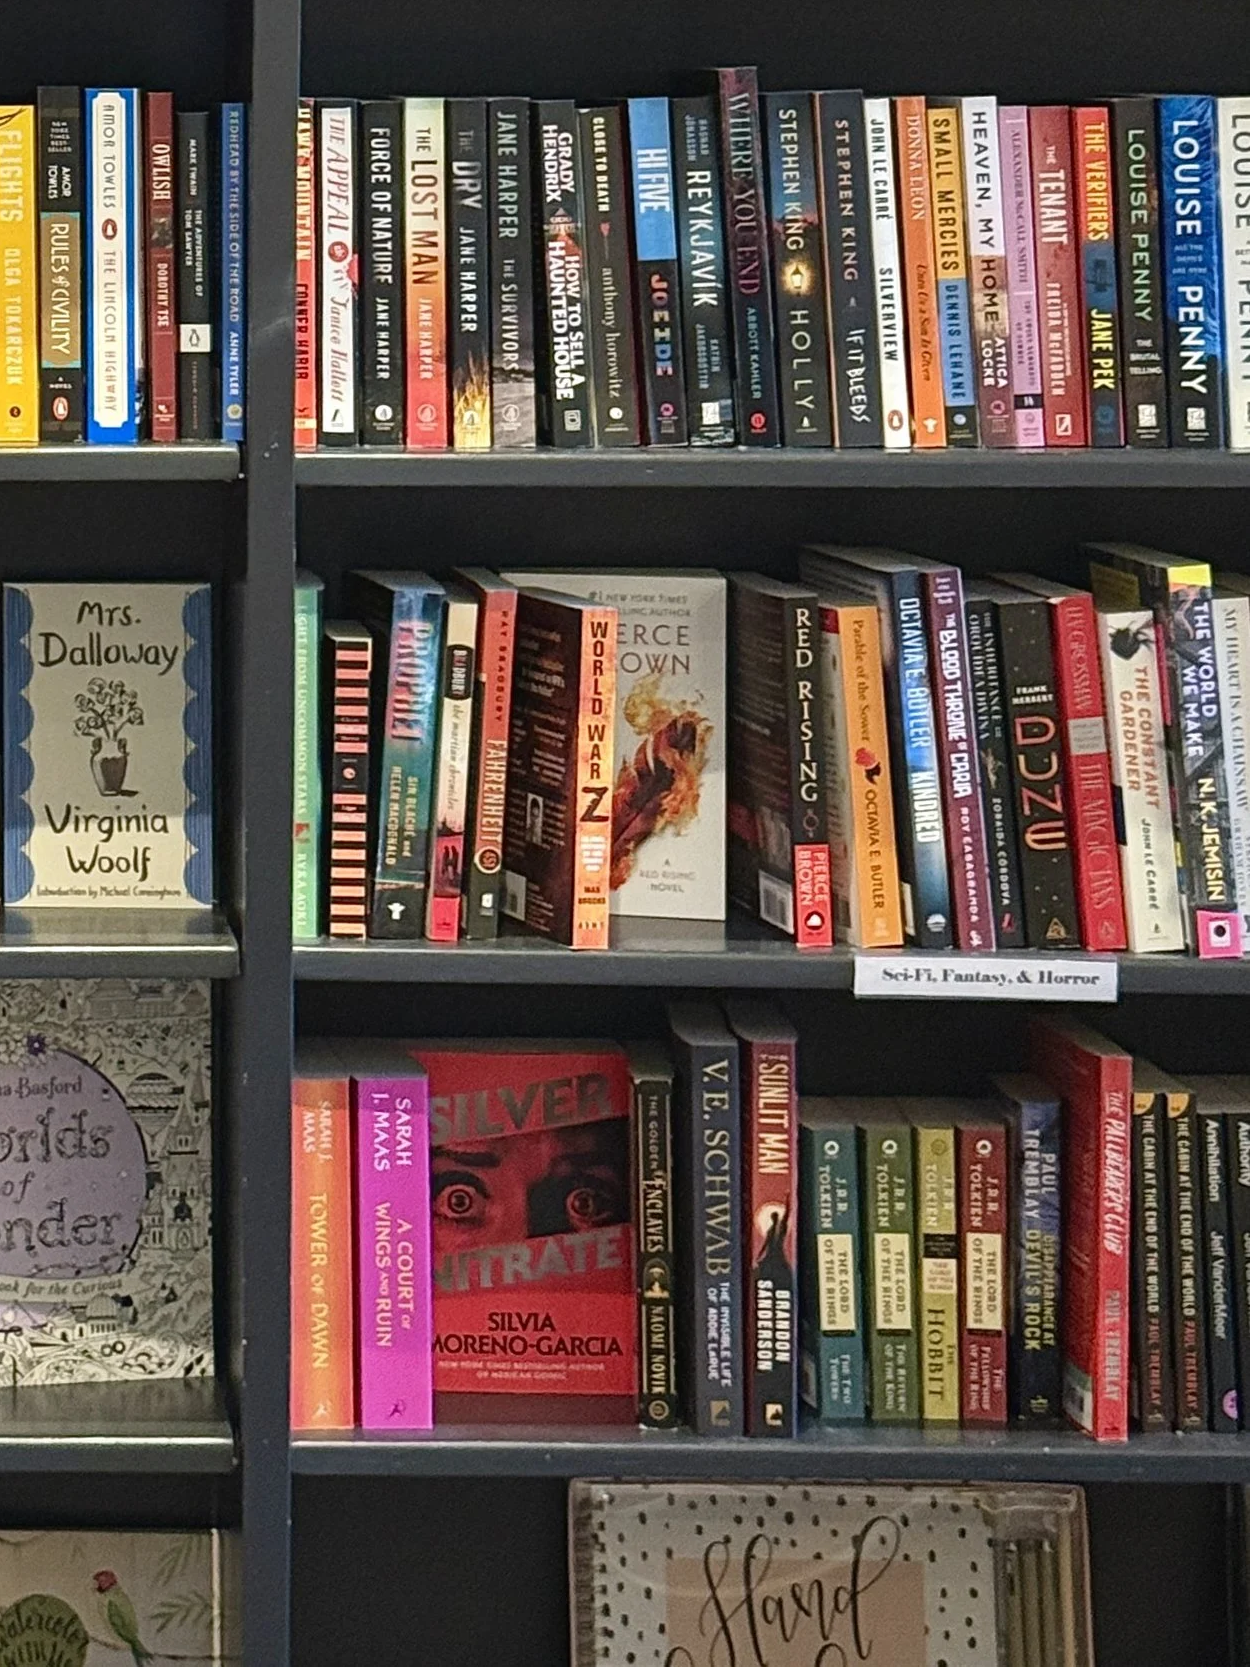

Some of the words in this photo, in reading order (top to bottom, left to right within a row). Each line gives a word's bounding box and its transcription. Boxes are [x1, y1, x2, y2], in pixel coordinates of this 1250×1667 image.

[497, 111, 516, 156] JANE
[1085, 122, 1106, 154] THE
[152, 144, 170, 200] OWLISH
[498, 165, 518, 238] HARPER
[1086, 161, 1108, 241] VERIFIERS
[157, 263, 168, 306] DOROTHY
[503, 259, 514, 278] THE
[158, 309, 169, 326] TSE
[501, 284, 519, 371] SURVIVORS
[1090, 309, 1113, 351] JANE
[1092, 358, 1114, 390] PEK
[77, 601, 141, 626] Mrs.
[38, 633, 179, 675] Dalloway
[590, 621, 607, 716] WORLD
[588, 724, 605, 780] WAR
[44, 803, 169, 842] Virginia
[580, 787, 609, 822] Z
[910, 771, 941, 842] KINDRED
[66, 845, 151, 882] Woolf
[883, 968, 937, 983] Sci-Fi,
[943, 969, 1012, 986] Fantasy,
[1016, 972, 1032, 983] &
[1039, 971, 1099, 984] Horror
[702, 1059, 728, 1082] V.
[702, 1090, 727, 1120] E.
[703, 1128, 733, 1275] SCHWAB
[488, 1312, 555, 1332] SILVIA
[924, 1308, 944, 1400] HOBBIT
